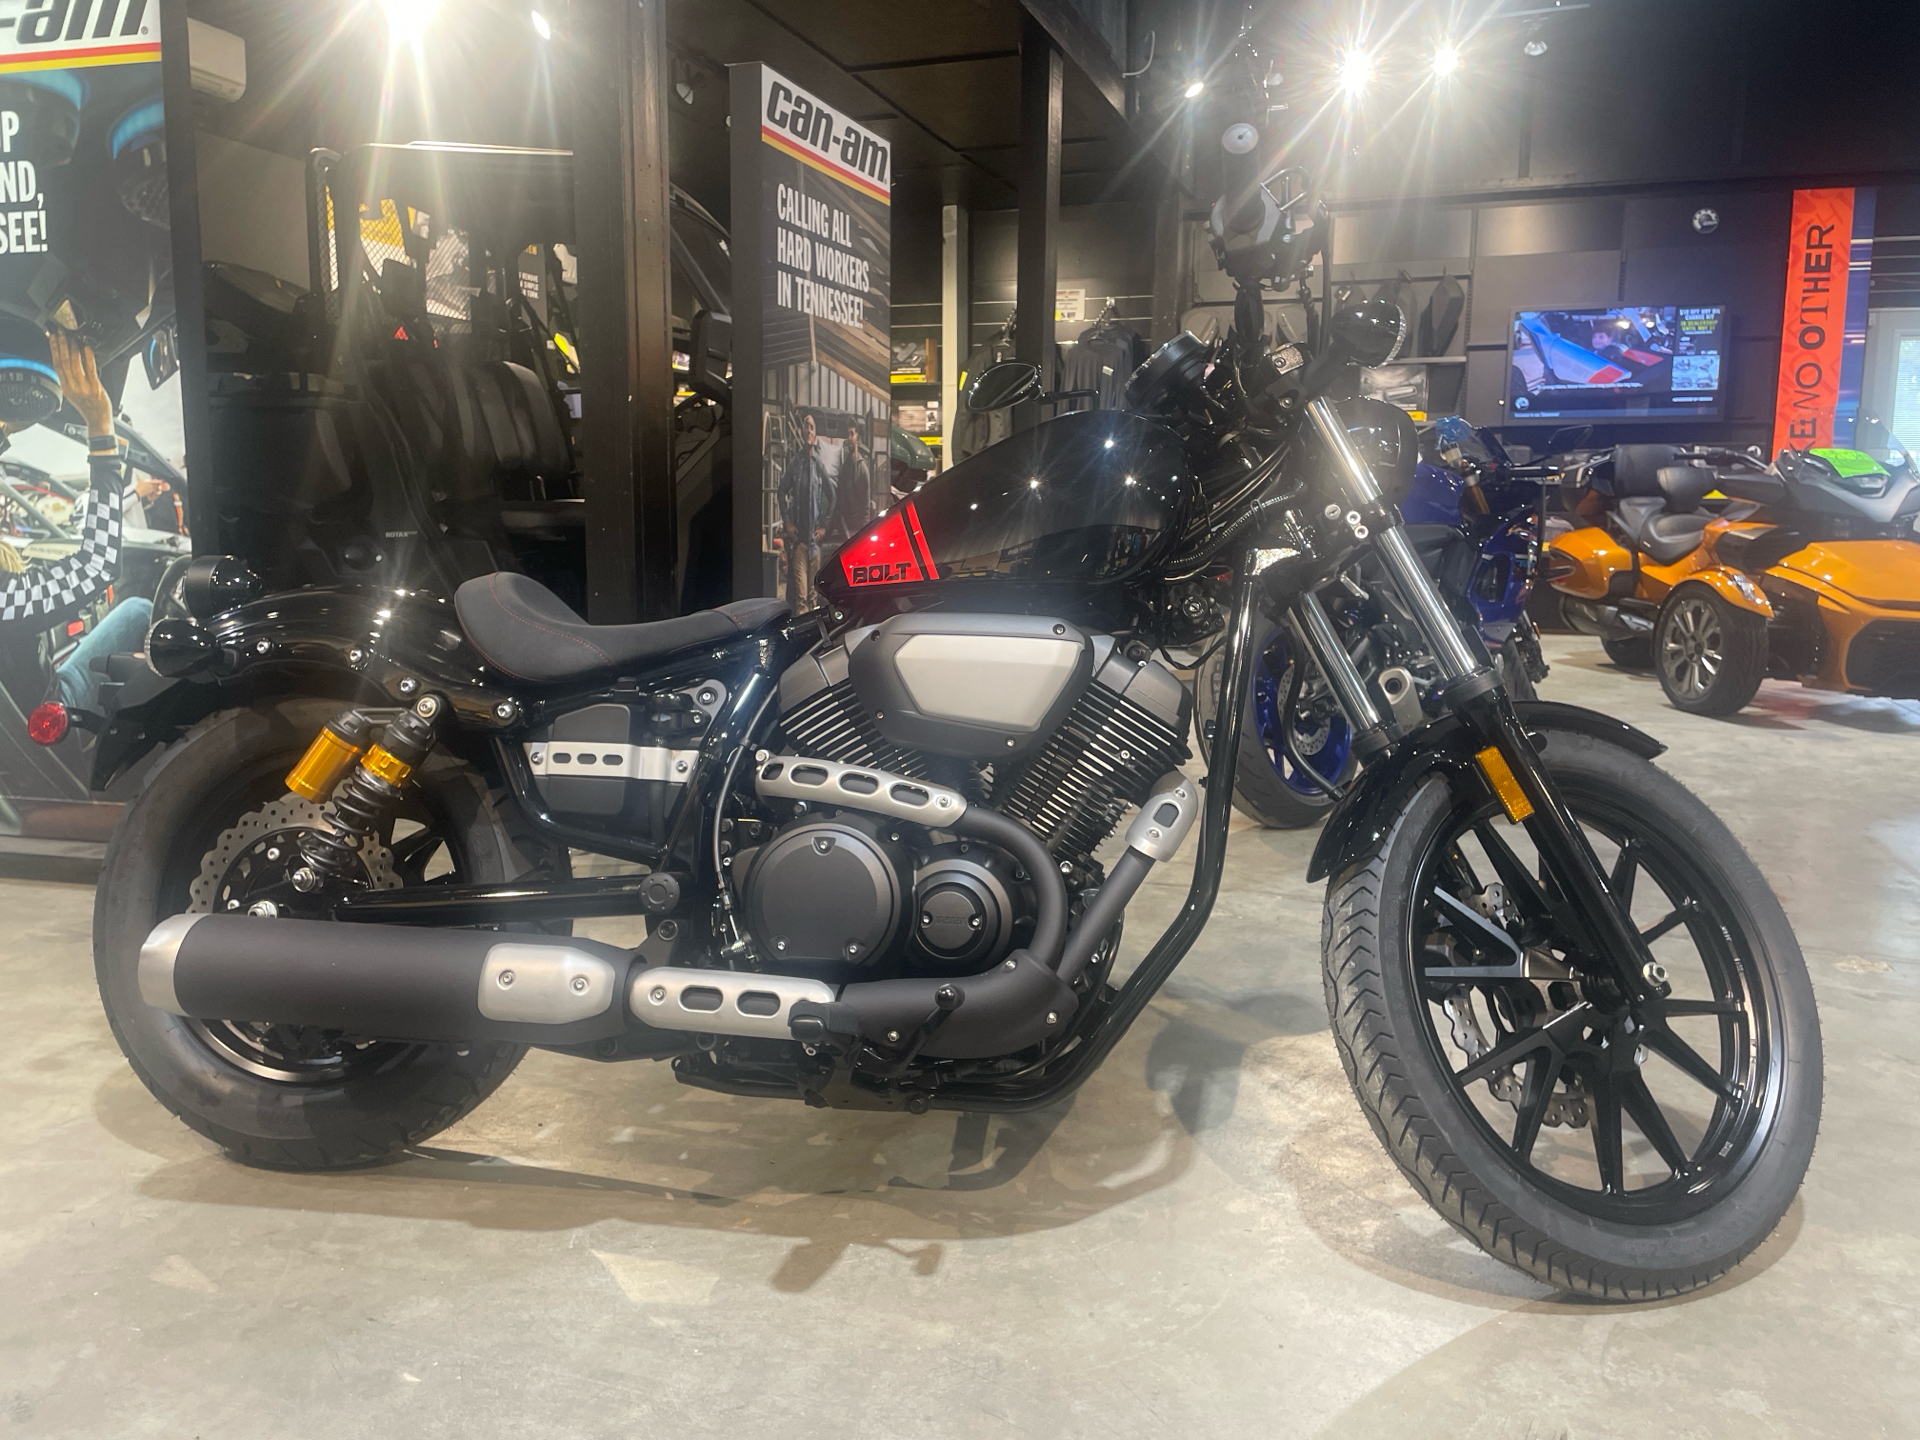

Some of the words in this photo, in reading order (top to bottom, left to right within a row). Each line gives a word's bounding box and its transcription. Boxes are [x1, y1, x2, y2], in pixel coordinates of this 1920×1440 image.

[766, 80, 888, 183] can-am
[776, 182, 829, 240] CALLING
[831, 208, 853, 248] ALL
[776, 226, 812, 273] HARD
[814, 241, 870, 293] WORKERS
[1798, 224, 1835, 350] OTHER
[776, 269, 792, 309] IN
[794, 276, 864, 329] TENNESSEE!
[852, 562, 912, 585] BOLT
